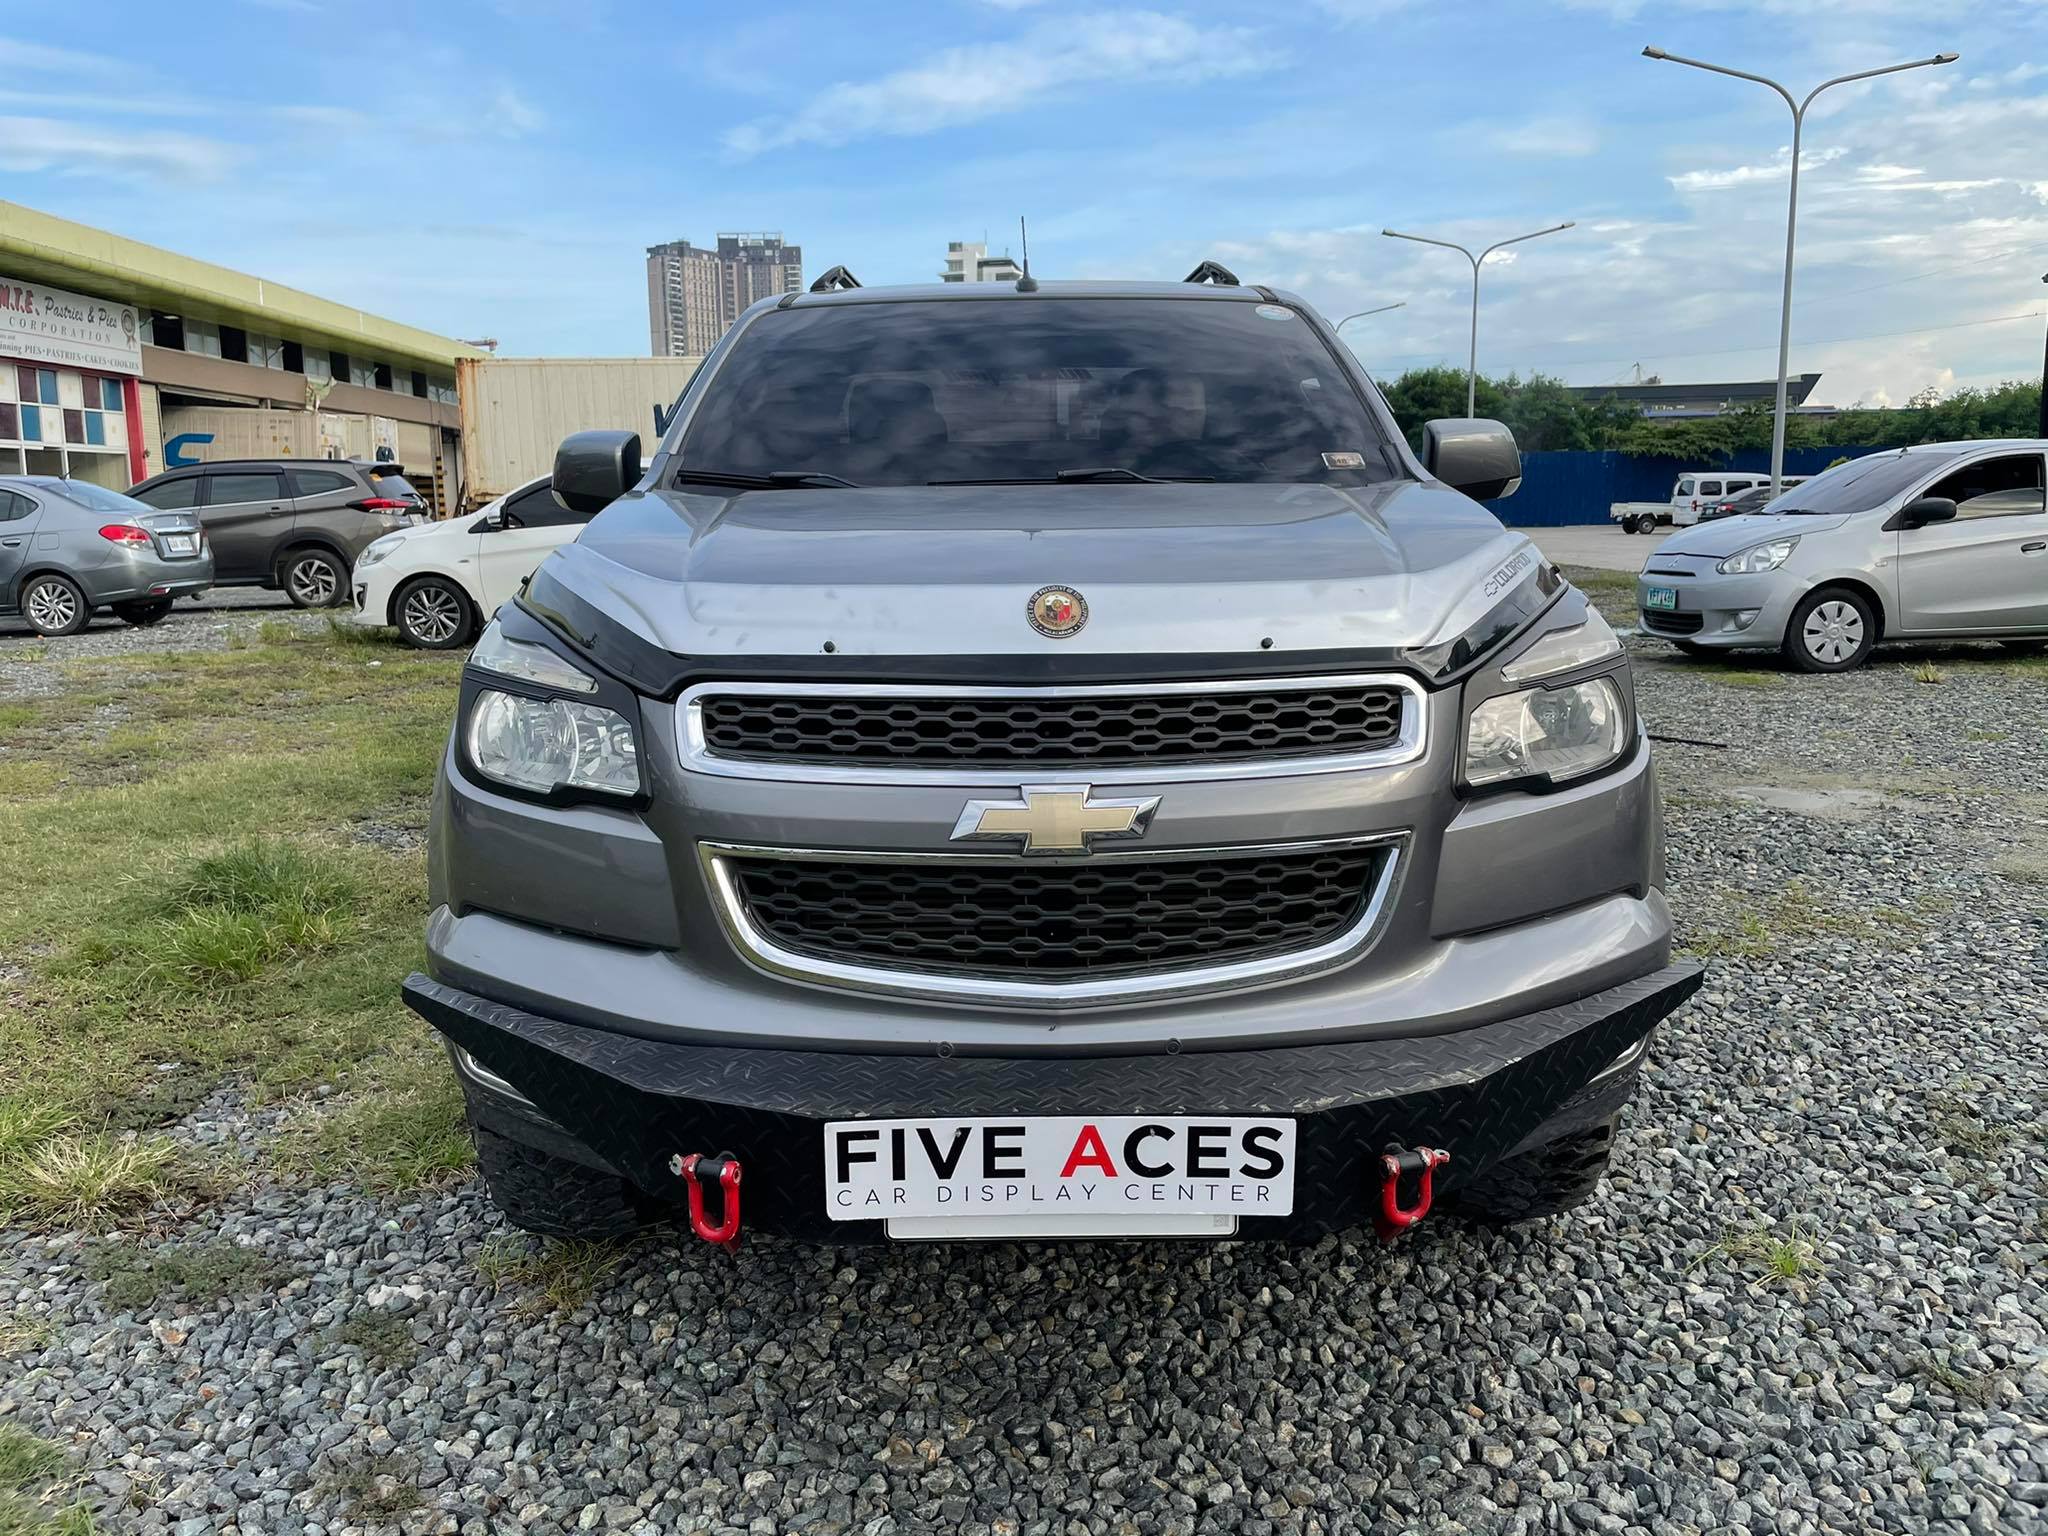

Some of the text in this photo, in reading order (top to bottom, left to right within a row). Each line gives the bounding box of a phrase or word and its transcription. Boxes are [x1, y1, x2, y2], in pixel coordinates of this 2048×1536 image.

[45, 296, 83, 322] Pastries
[88, 305, 95, 323] &
[98, 308, 117, 328] Pies
[9, 317, 111, 343] CORPORATION
[25, 344, 42, 355] PIES
[46, 348, 81, 361] PASTRIES
[110, 360, 139, 370] COOKIES
[1493, 552, 1531, 587] COLORADO
[835, 1124, 1285, 1183] FIVE ACES
[837, 1183, 1270, 1207] CAR DISPLAY CENTER
